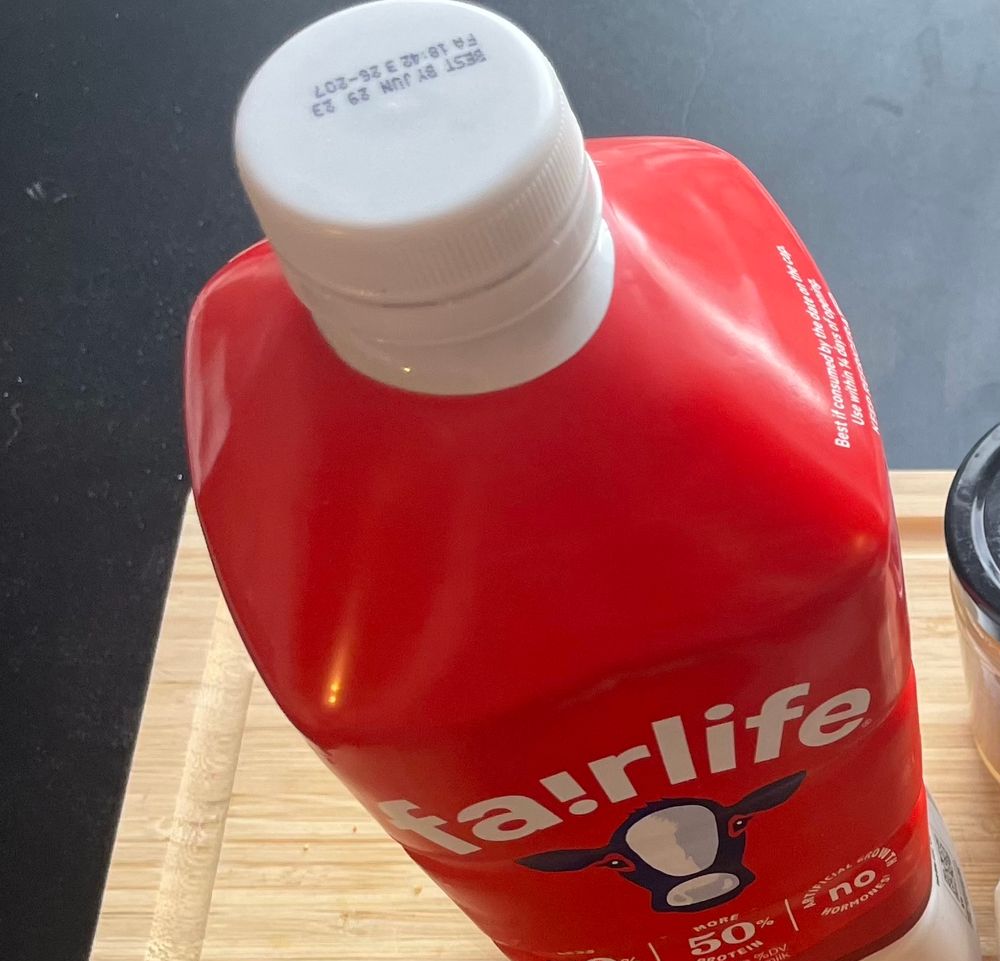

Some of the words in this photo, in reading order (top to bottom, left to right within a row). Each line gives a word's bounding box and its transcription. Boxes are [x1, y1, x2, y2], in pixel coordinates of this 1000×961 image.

[385, 60, 398, 73] 3
[446, 49, 487, 72] BEST
[314, 65, 382, 99] 26-207
[417, 64, 438, 82] BY
[380, 73, 412, 94] JUN
[347, 87, 370, 106] 29
[312, 99, 335, 117] 23
[786, 264, 804, 284] the
[796, 283, 810, 297] on
[803, 296, 821, 321] date
[811, 321, 827, 340] the
[825, 318, 839, 333] of
[817, 339, 833, 354] by
[831, 332, 848, 357] days
[839, 358, 851, 370] 14
[820, 354, 844, 410] consumed
[843, 370, 861, 404] within
[831, 410, 847, 420] if
[851, 405, 865, 426] Use
[834, 420, 850, 448] Best
[828, 870, 876, 902] no
[693, 913, 739, 932] MORE
[688, 916, 775, 956] 50%
[754, 944, 788, 961] %DV
